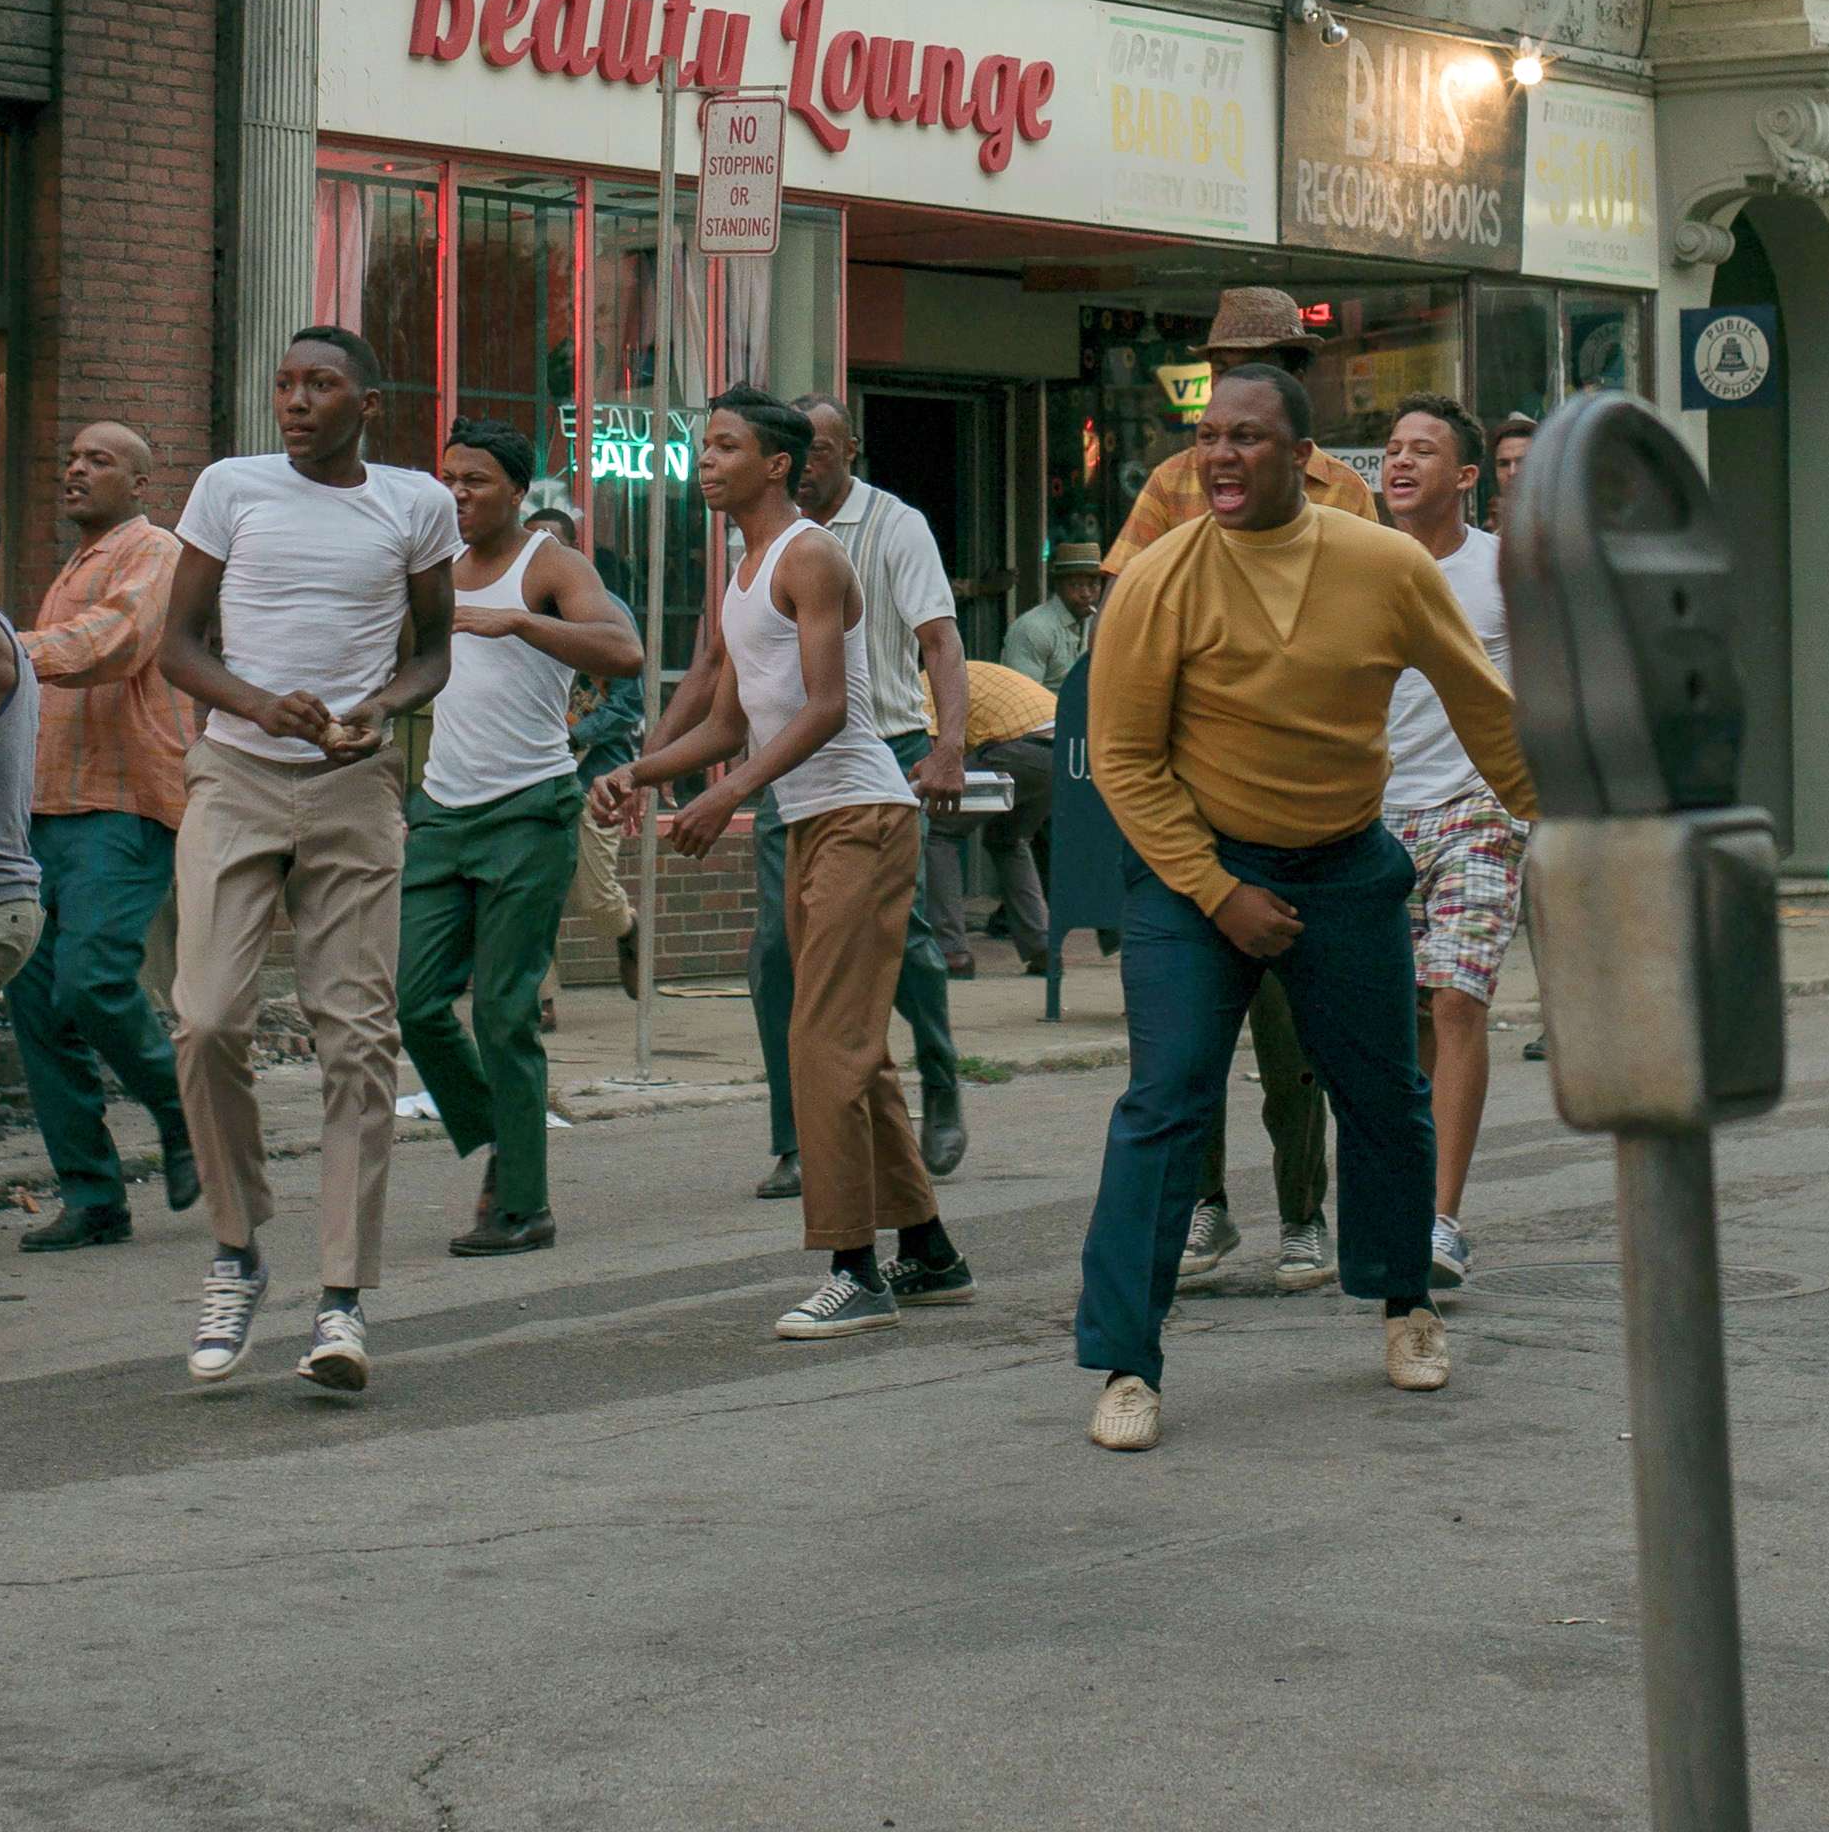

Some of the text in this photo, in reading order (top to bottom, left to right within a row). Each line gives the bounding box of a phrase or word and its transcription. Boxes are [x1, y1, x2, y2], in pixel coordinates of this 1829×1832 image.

[729, 115, 758, 145] NO
[708, 155, 775, 176] STOPPING
[730, 186, 750, 206] OR
[1296, 158, 1404, 239] RECORDS
[1422, 178, 1502, 248] BOOKS
[704, 217, 772, 238] STANDING
[1705, 319, 1758, 340] PUBLIC
[1698, 366, 1765, 398] TELEPHONE
